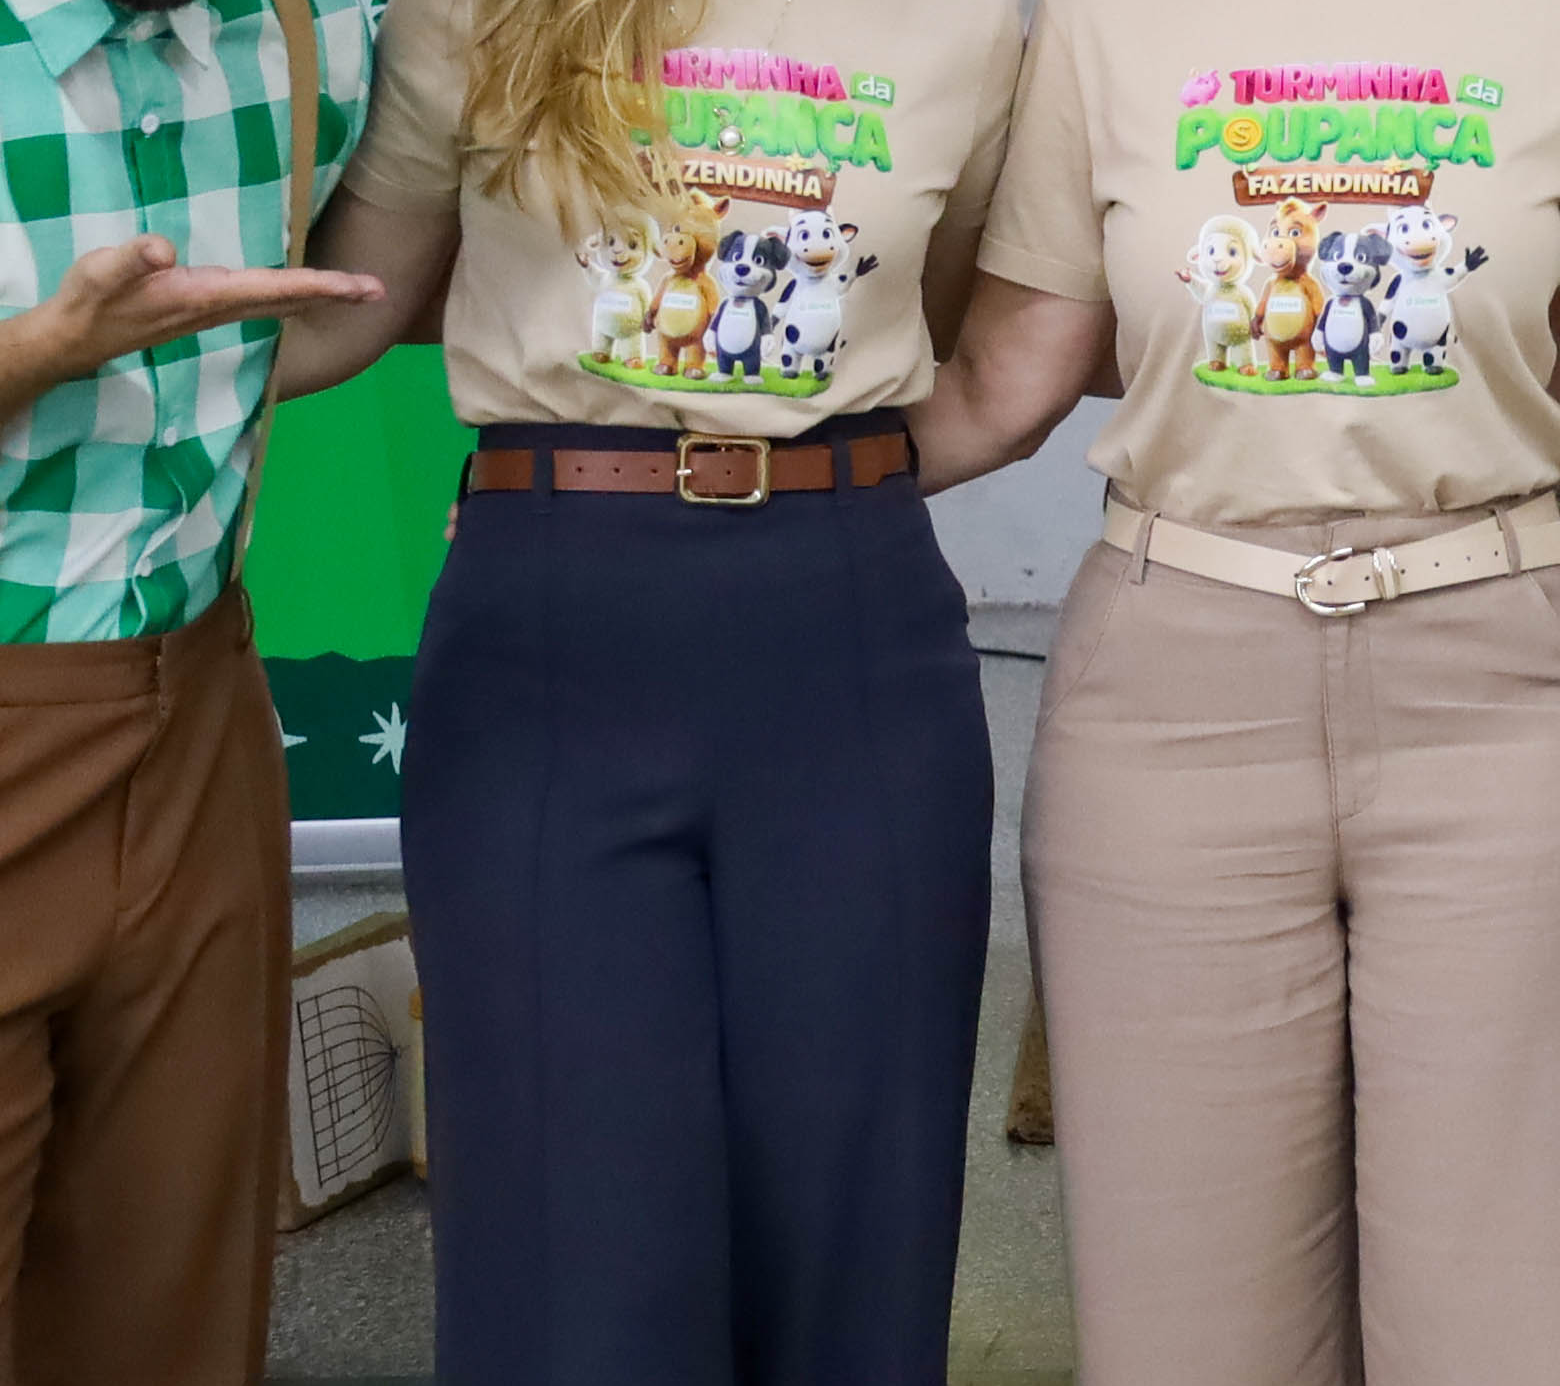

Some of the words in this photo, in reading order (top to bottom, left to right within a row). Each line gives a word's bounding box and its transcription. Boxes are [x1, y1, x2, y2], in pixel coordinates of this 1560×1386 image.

[661, 48, 848, 101] URMINHA
[858, 75, 891, 102] da
[1229, 61, 1450, 105] TURMINHA
[1465, 79, 1500, 105] da
[663, 90, 893, 173] UPANÇA
[1175, 105, 1496, 171] POUPANÇA
[682, 160, 823, 200] ZENDINHA
[1247, 171, 1420, 197] FAZENDINHA
